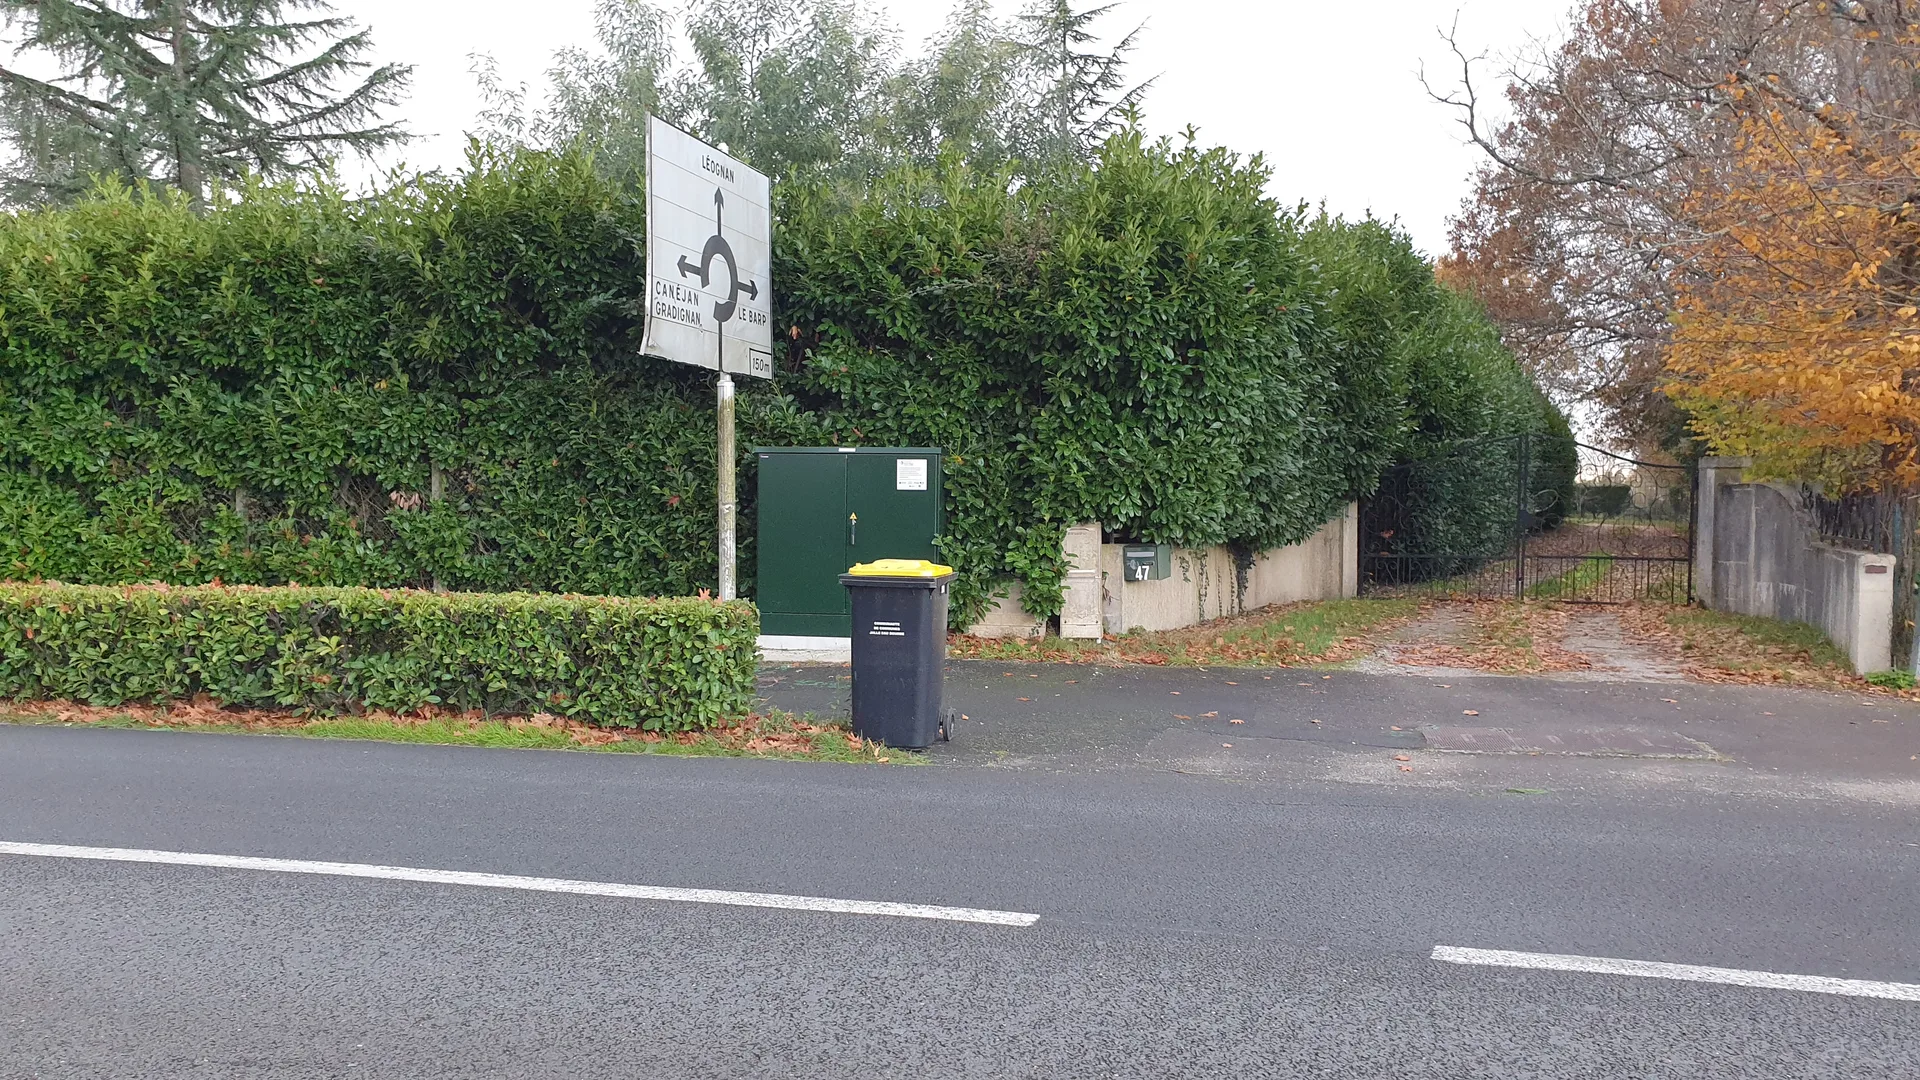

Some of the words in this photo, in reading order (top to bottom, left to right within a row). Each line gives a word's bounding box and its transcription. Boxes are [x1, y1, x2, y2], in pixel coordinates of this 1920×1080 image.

[701, 154, 735, 184] LÉOGNAN
[655, 280, 699, 306] CANÉJAN
[655, 301, 701, 325] GRADIGNAN
[738, 306, 746, 321] LE
[749, 310, 767, 326] BARP
[1135, 565, 1150, 580] 47
